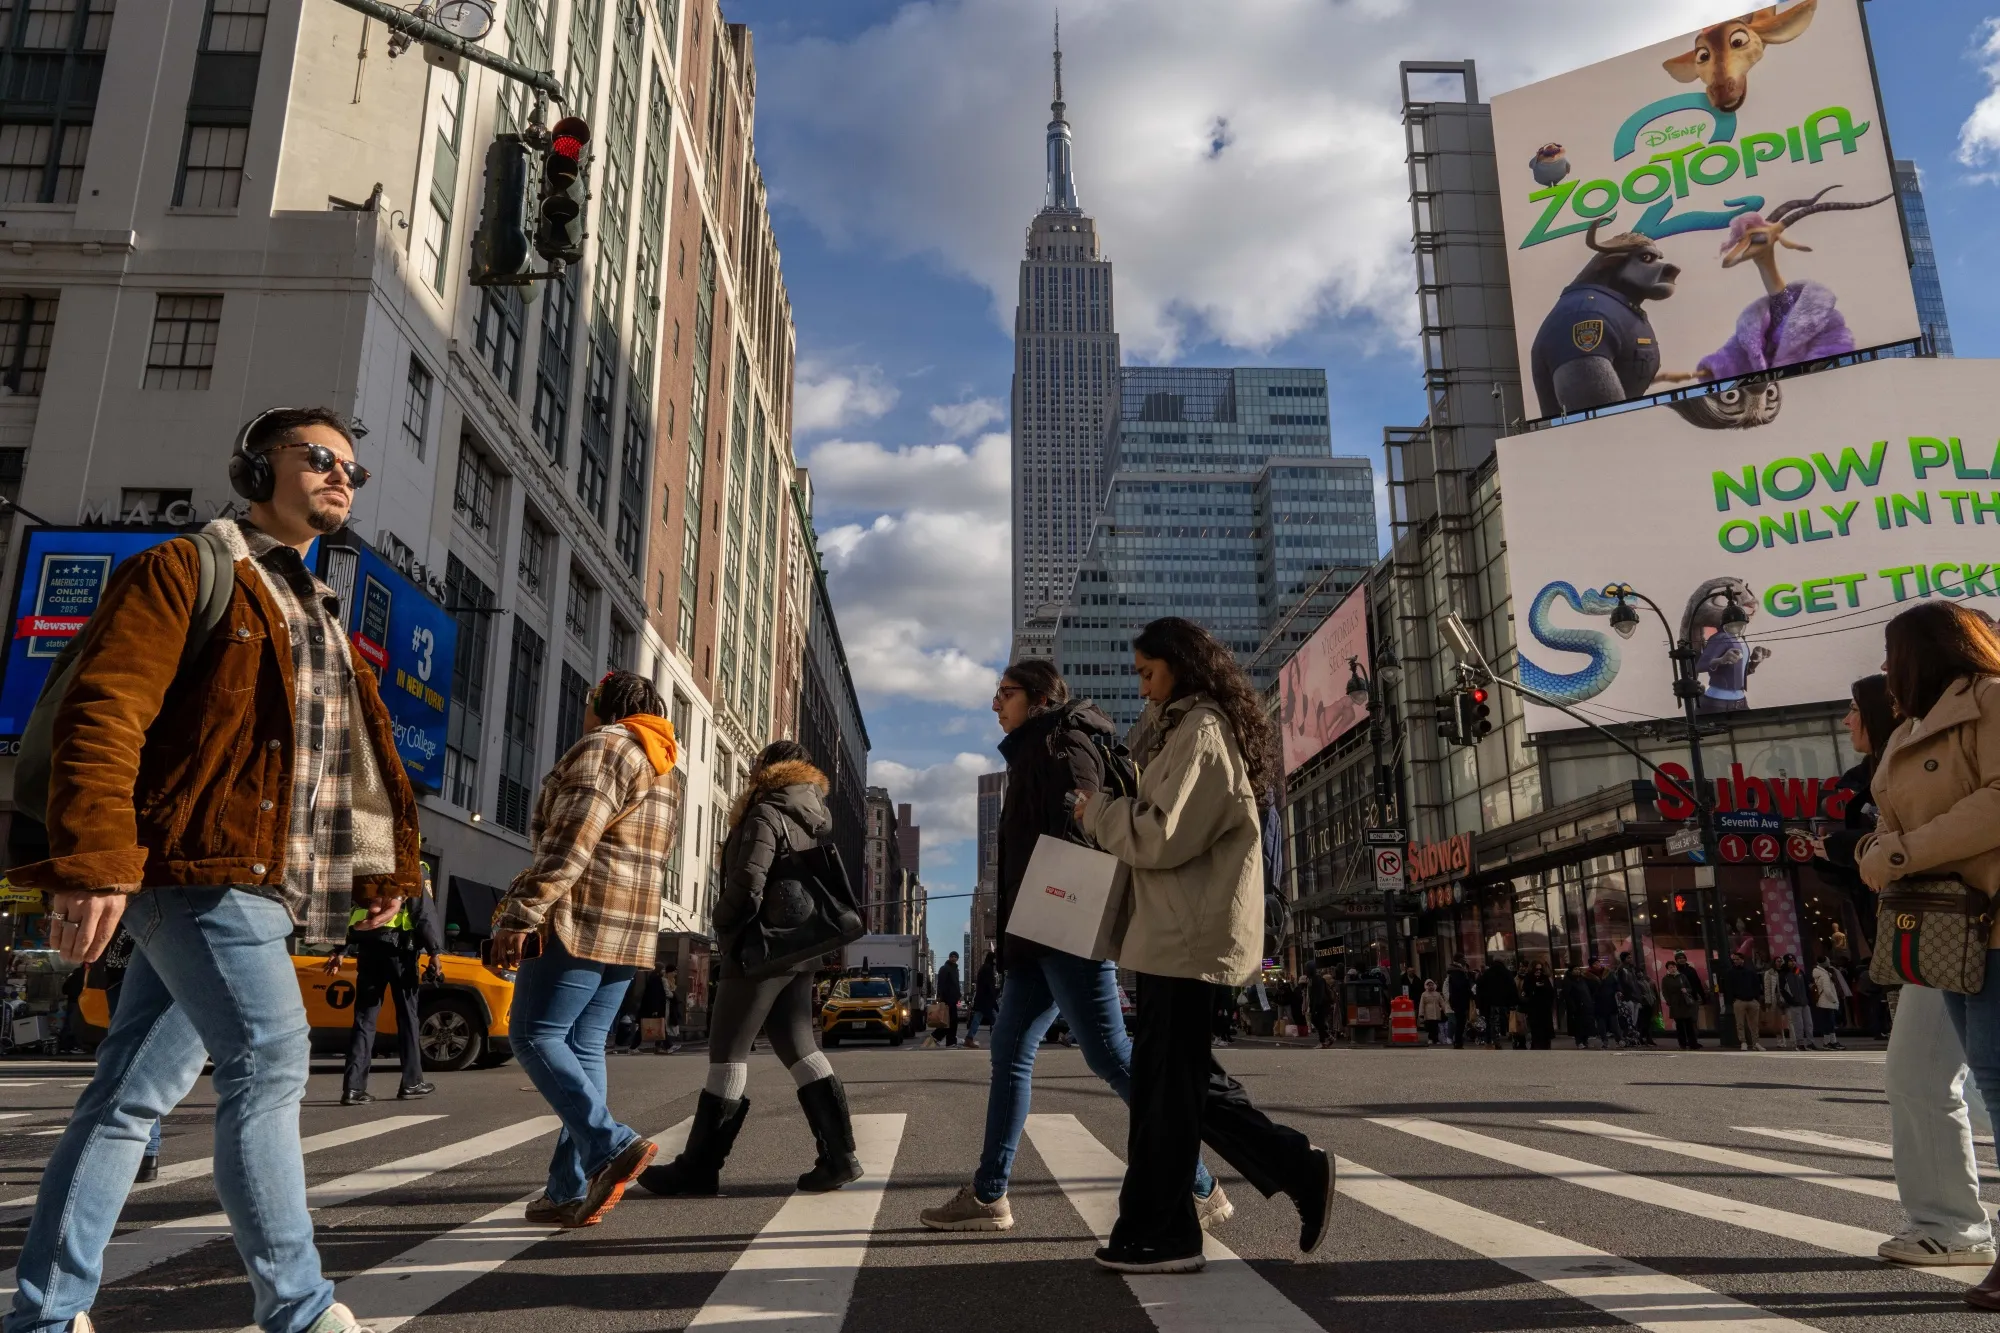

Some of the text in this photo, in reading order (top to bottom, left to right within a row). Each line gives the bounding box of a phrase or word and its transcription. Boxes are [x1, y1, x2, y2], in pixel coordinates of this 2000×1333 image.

[1712, 436, 2000, 511] NOW PL
[1718, 490, 2000, 554] ONLY IN TH
[48, 596, 94, 604] COLLEGES
[50, 579, 98, 587] AMERICA'S TOP
[1763, 562, 2000, 618] GET TICK
[60, 605, 78, 614] 2025
[411, 624, 434, 682] #3
[396, 668, 445, 713] IN NEW YORK!
[406, 725, 436, 760] College
[1721, 817, 1779, 828] Seventh Ave
[1408, 831, 1471, 884] Subway
[1726, 838, 1808, 858] 1 2 3
